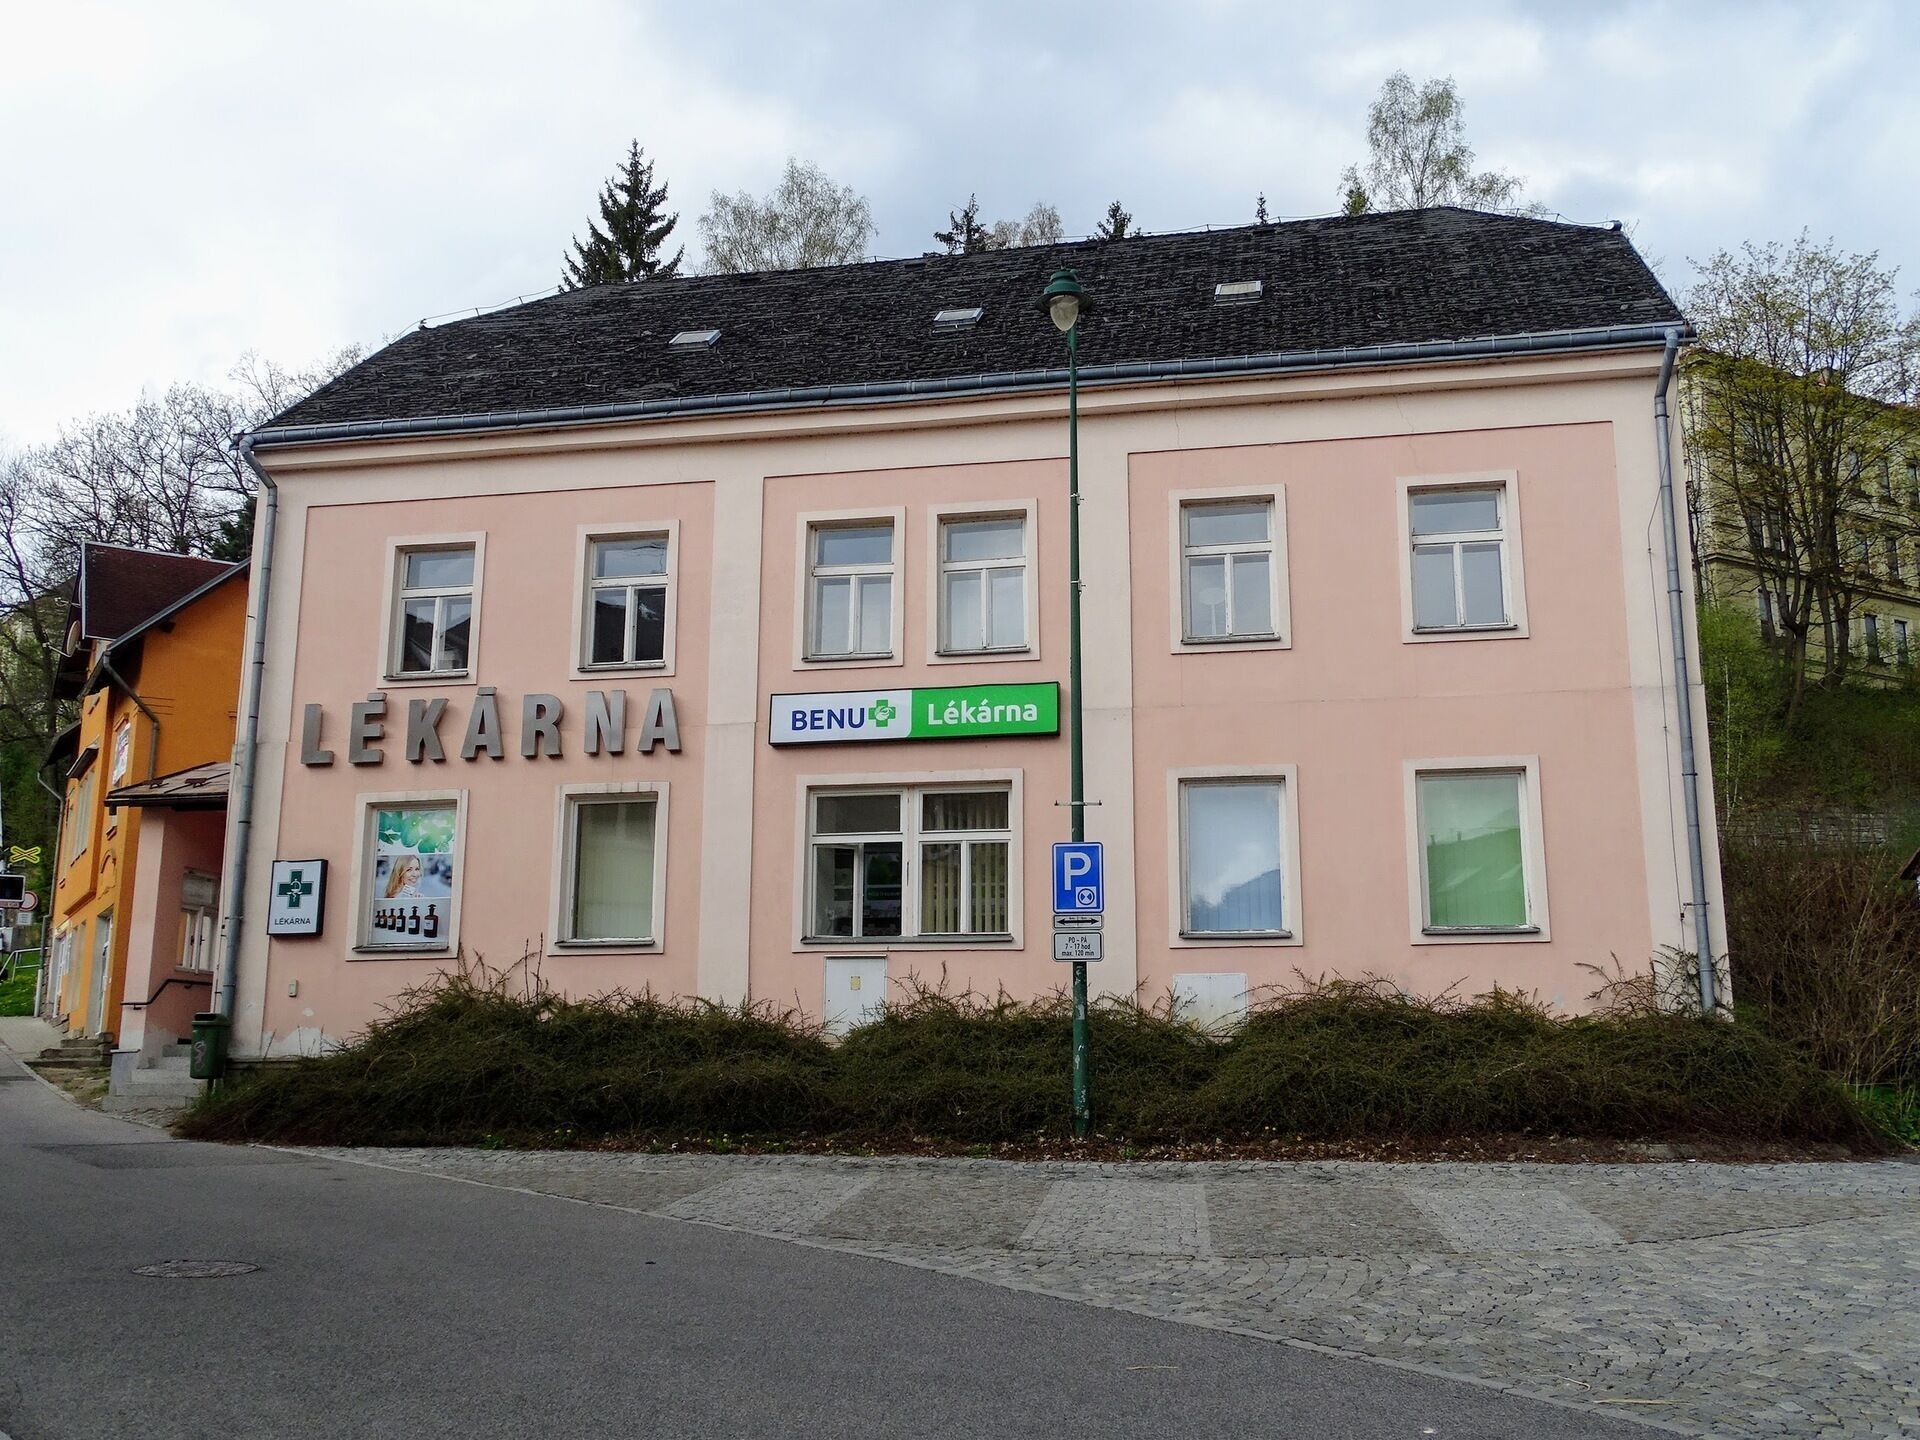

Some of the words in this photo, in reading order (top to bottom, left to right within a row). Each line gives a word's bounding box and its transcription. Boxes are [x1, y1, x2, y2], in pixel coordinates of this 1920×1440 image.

[300, 686, 682, 765] LÉKÁRNA
[791, 707, 865, 731] BENU
[928, 698, 1038, 726] Lékárna
[1063, 852, 1091, 891] P
[274, 917, 311, 925] LÉKÁRNA
